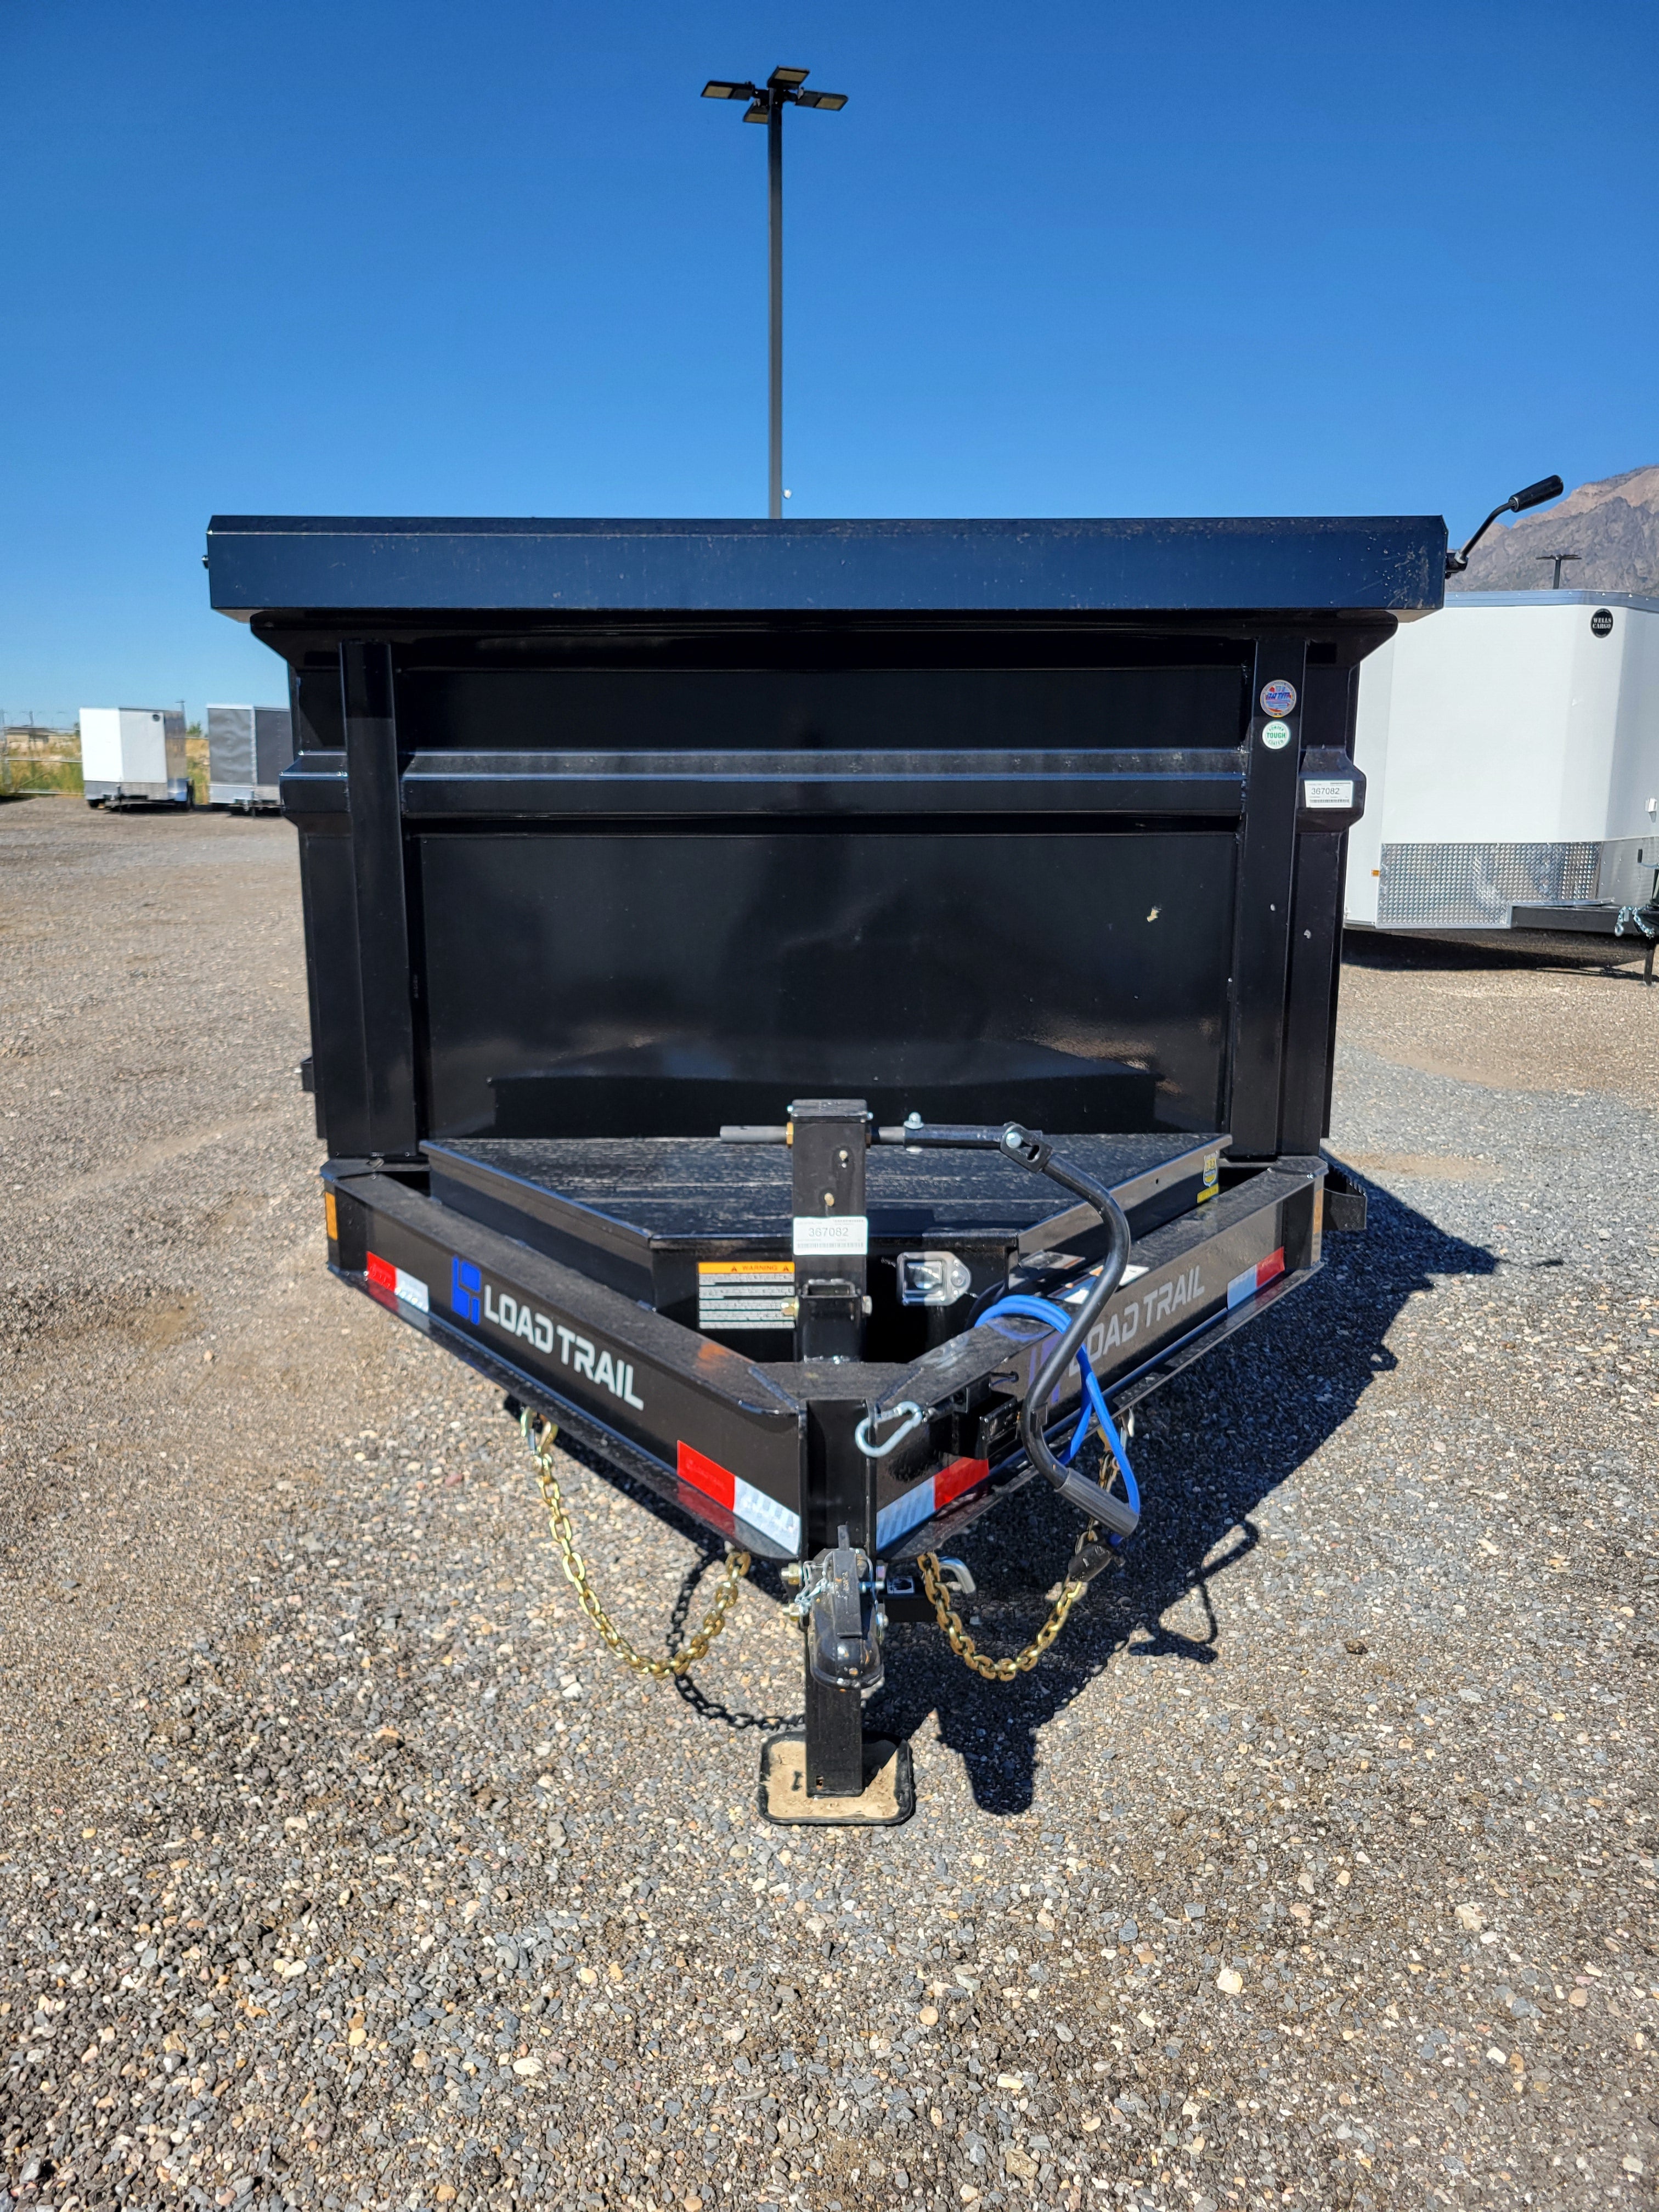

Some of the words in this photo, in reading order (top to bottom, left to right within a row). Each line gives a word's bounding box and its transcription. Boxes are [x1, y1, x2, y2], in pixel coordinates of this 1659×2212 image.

[808, 1227, 849, 1237] 367082
[1143, 1265, 1205, 1328] TRAIL
[484, 1284, 554, 1354] LOAD
[556, 1324, 644, 1412] TRAIL
